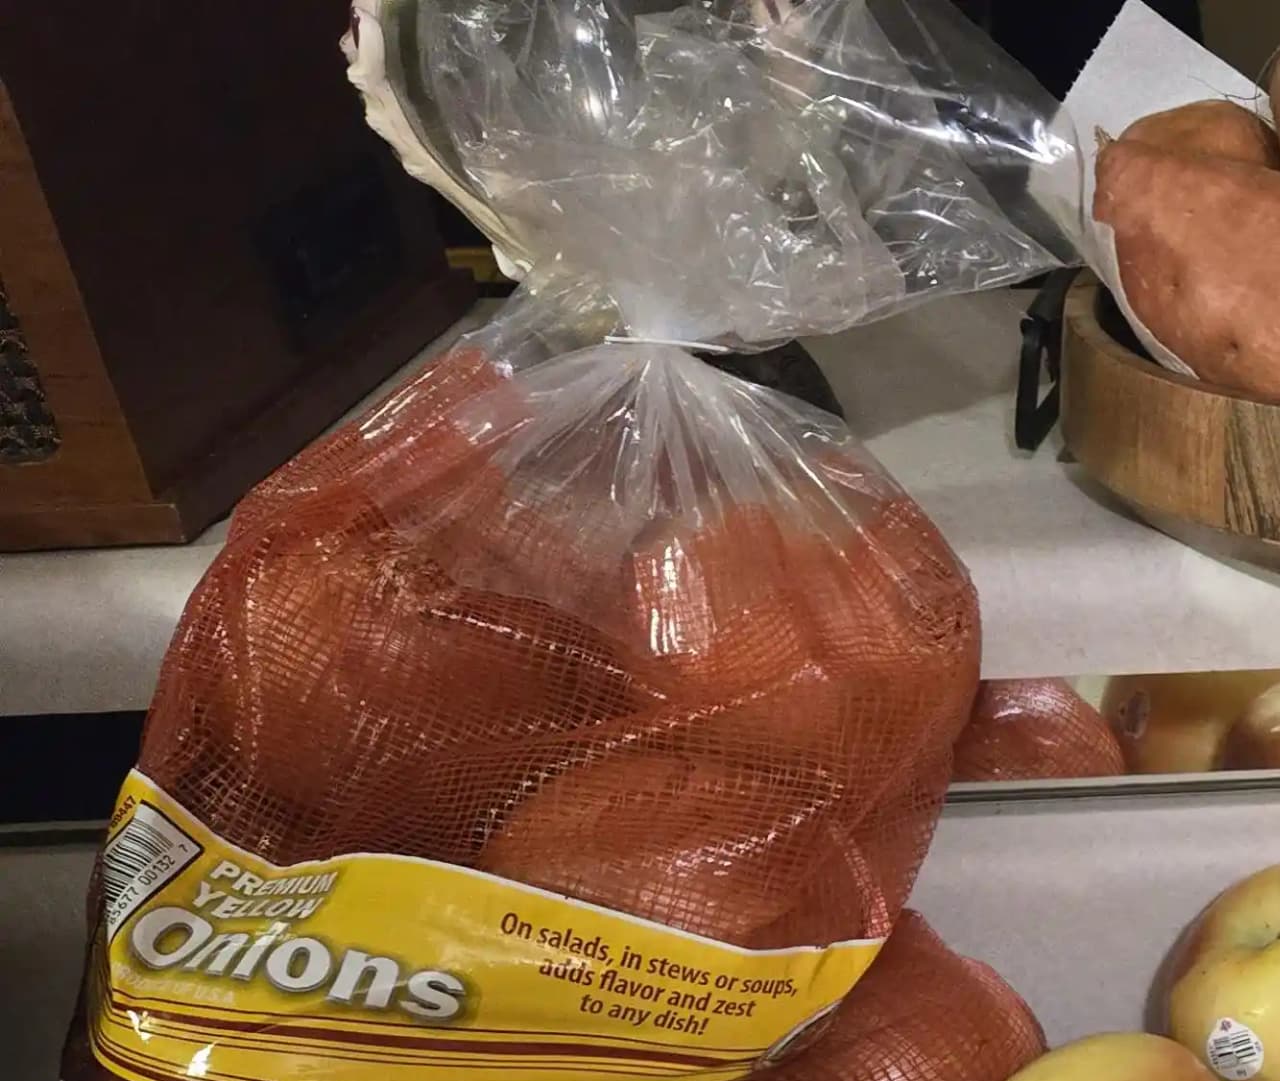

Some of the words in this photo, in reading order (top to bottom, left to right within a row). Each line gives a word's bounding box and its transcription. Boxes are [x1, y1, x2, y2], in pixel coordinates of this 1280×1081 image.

[138, 855, 176, 886] 00132
[210, 860, 338, 896] PREMIUM
[193, 880, 324, 919] YELLOW
[132, 907, 463, 1020] Onions
[500, 912, 532, 939] On
[536, 928, 615, 966] salads,
[620, 945, 642, 970] in
[646, 956, 711, 986] stews
[714, 973, 739, 991] or
[741, 975, 798, 999] soups,
[539, 957, 595, 985] adds
[599, 969, 664, 1001] flavor
[667, 989, 712, 1011] and
[712, 998, 756, 1018] zest
[579, 993, 604, 1014] to
[607, 1006, 652, 1028] any
[653, 1010, 710, 1036] dish!
